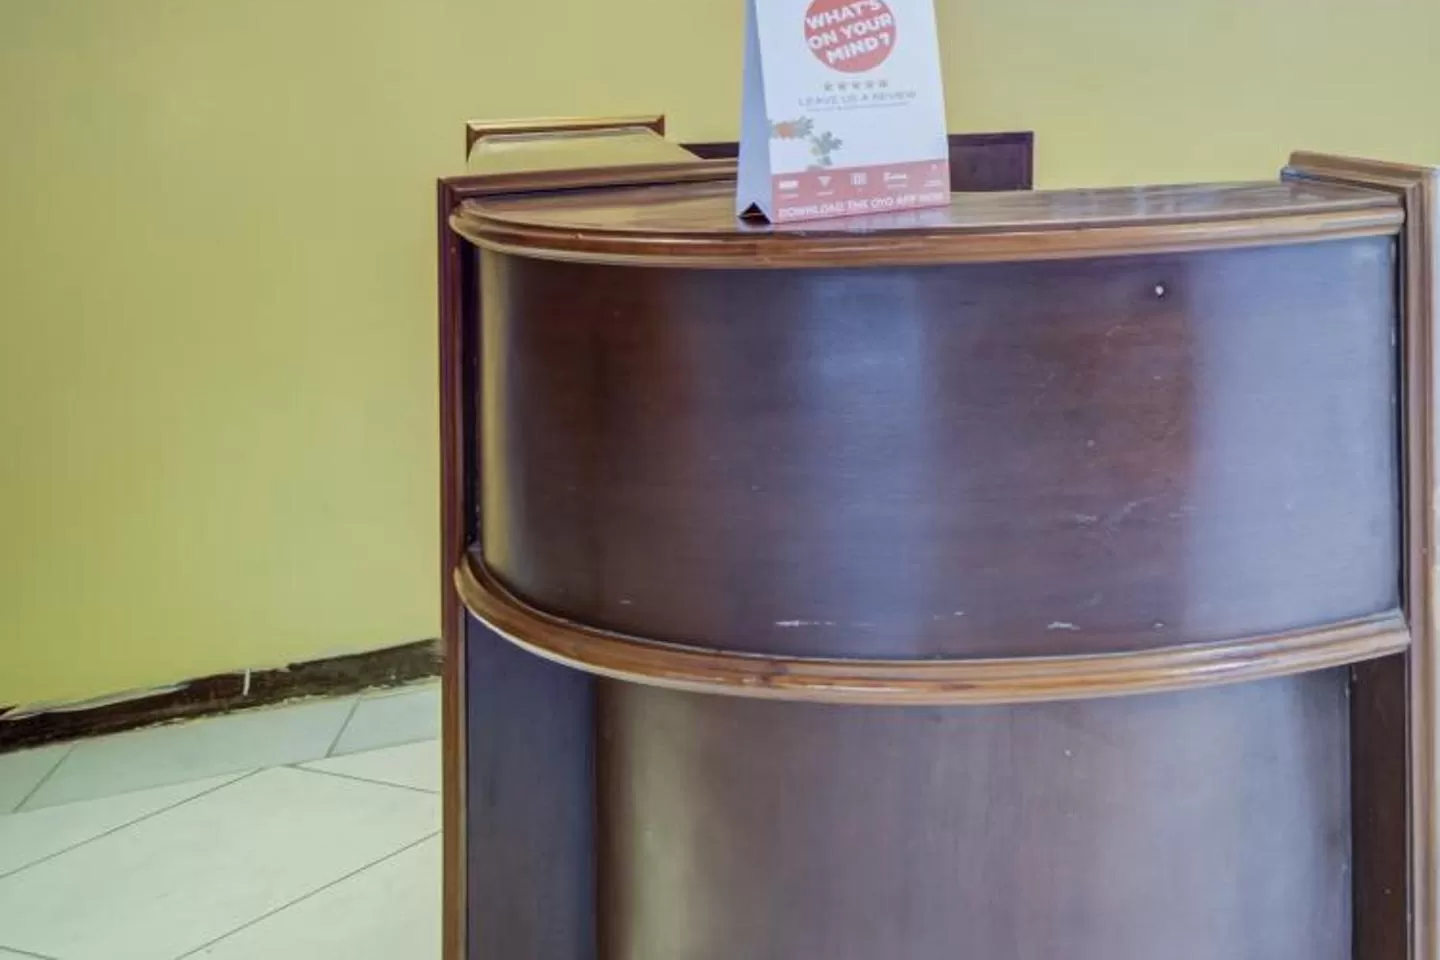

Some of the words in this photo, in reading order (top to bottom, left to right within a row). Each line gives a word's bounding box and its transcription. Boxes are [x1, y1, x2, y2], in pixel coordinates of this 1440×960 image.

[808, 29, 838, 51] ON
[840, 12, 894, 40] YOUR
[826, 32, 891, 65] MIND?
